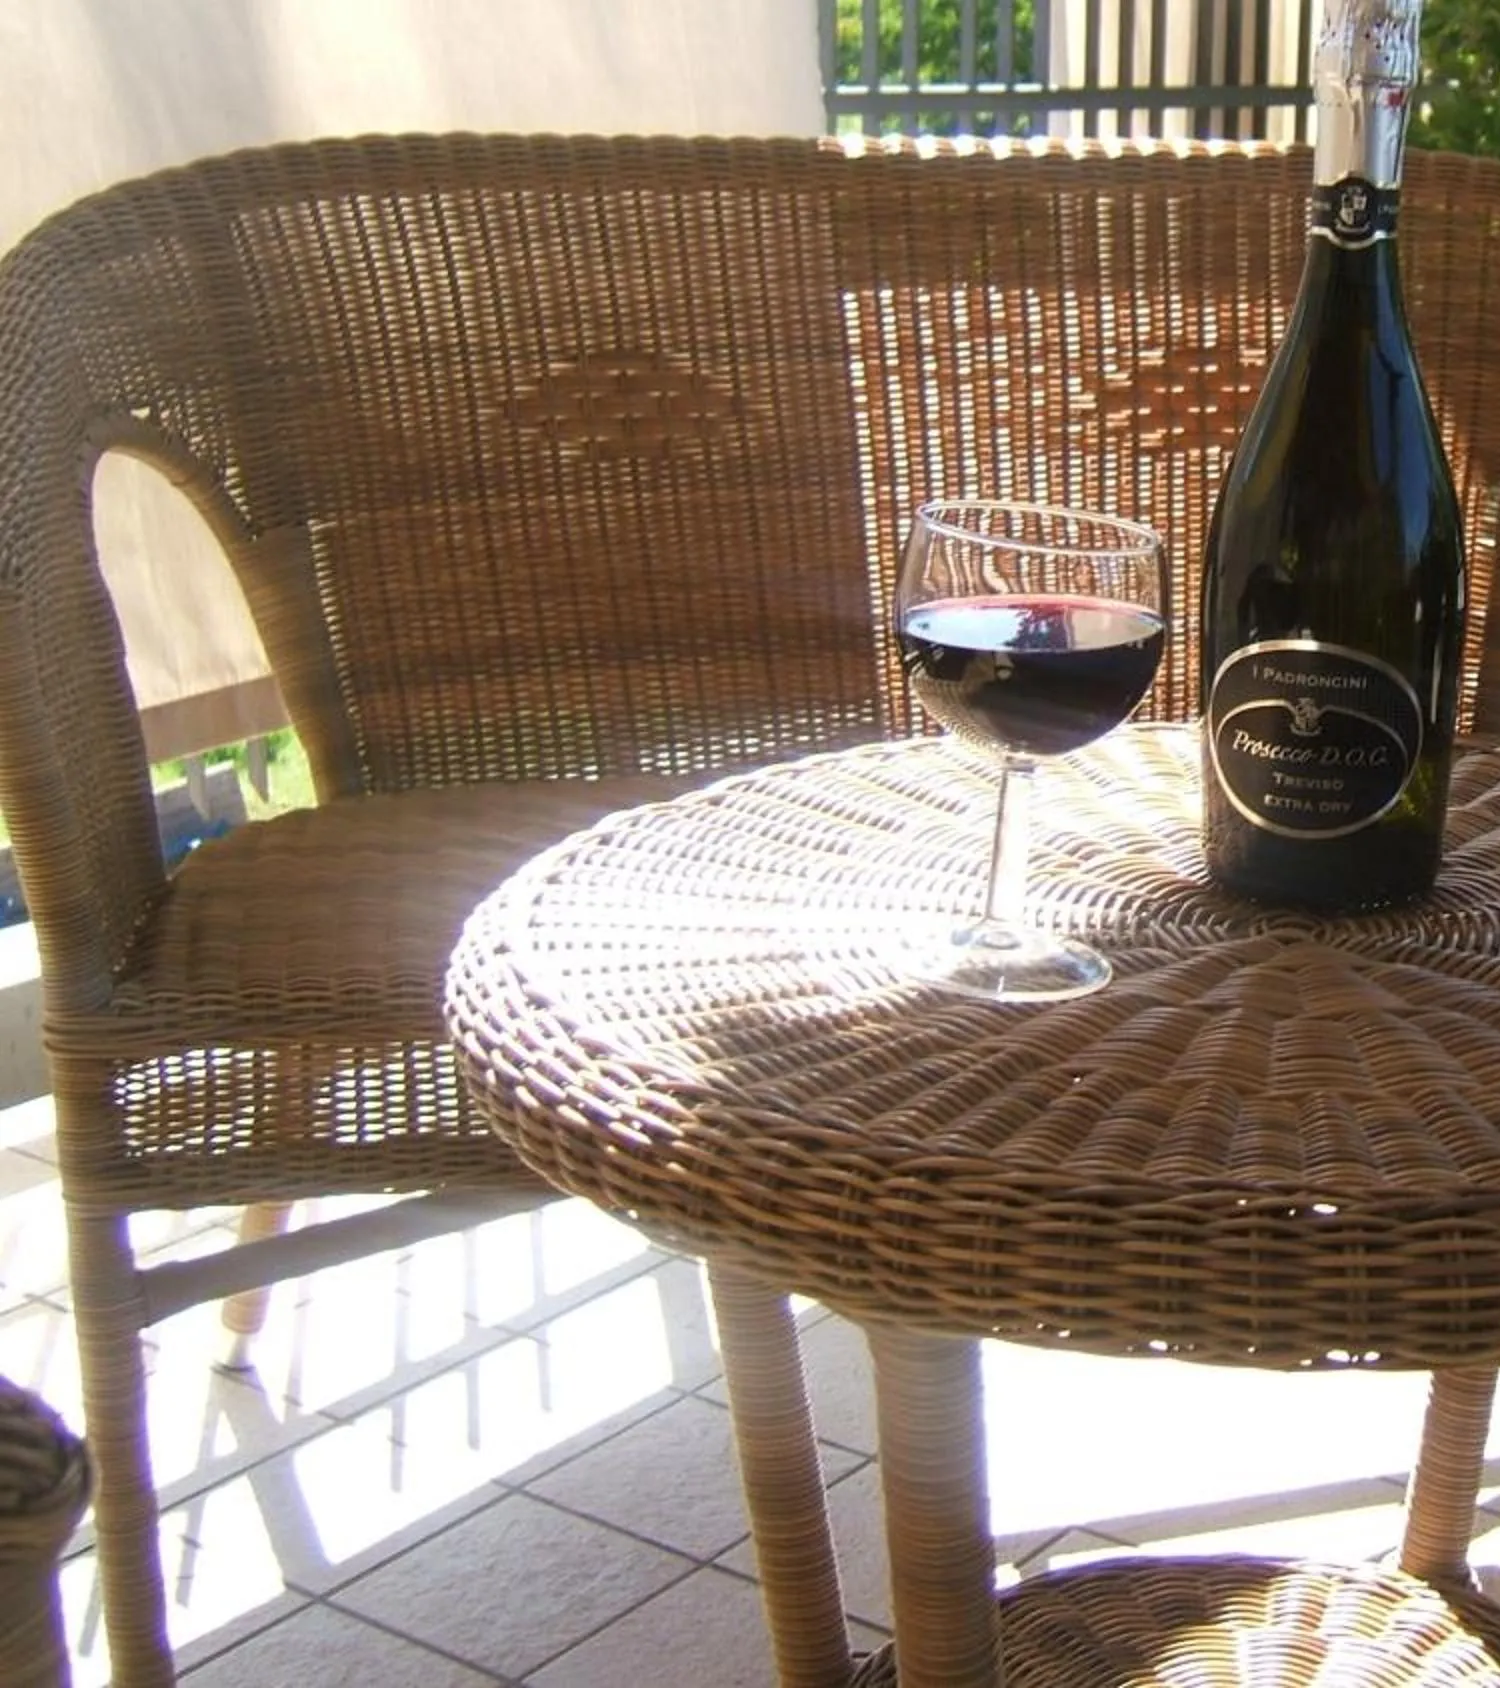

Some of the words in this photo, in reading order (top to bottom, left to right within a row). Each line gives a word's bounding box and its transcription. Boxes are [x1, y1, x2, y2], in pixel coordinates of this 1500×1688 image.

[1252, 664, 1258, 679] I
[1263, 667, 1367, 689] PADRONCINI
[1232, 728, 1313, 761] Prosecco
[1272, 771, 1344, 790] TREVISO
[1264, 794, 1313, 812] EXTRA
[1319, 801, 1351, 813] DRY
